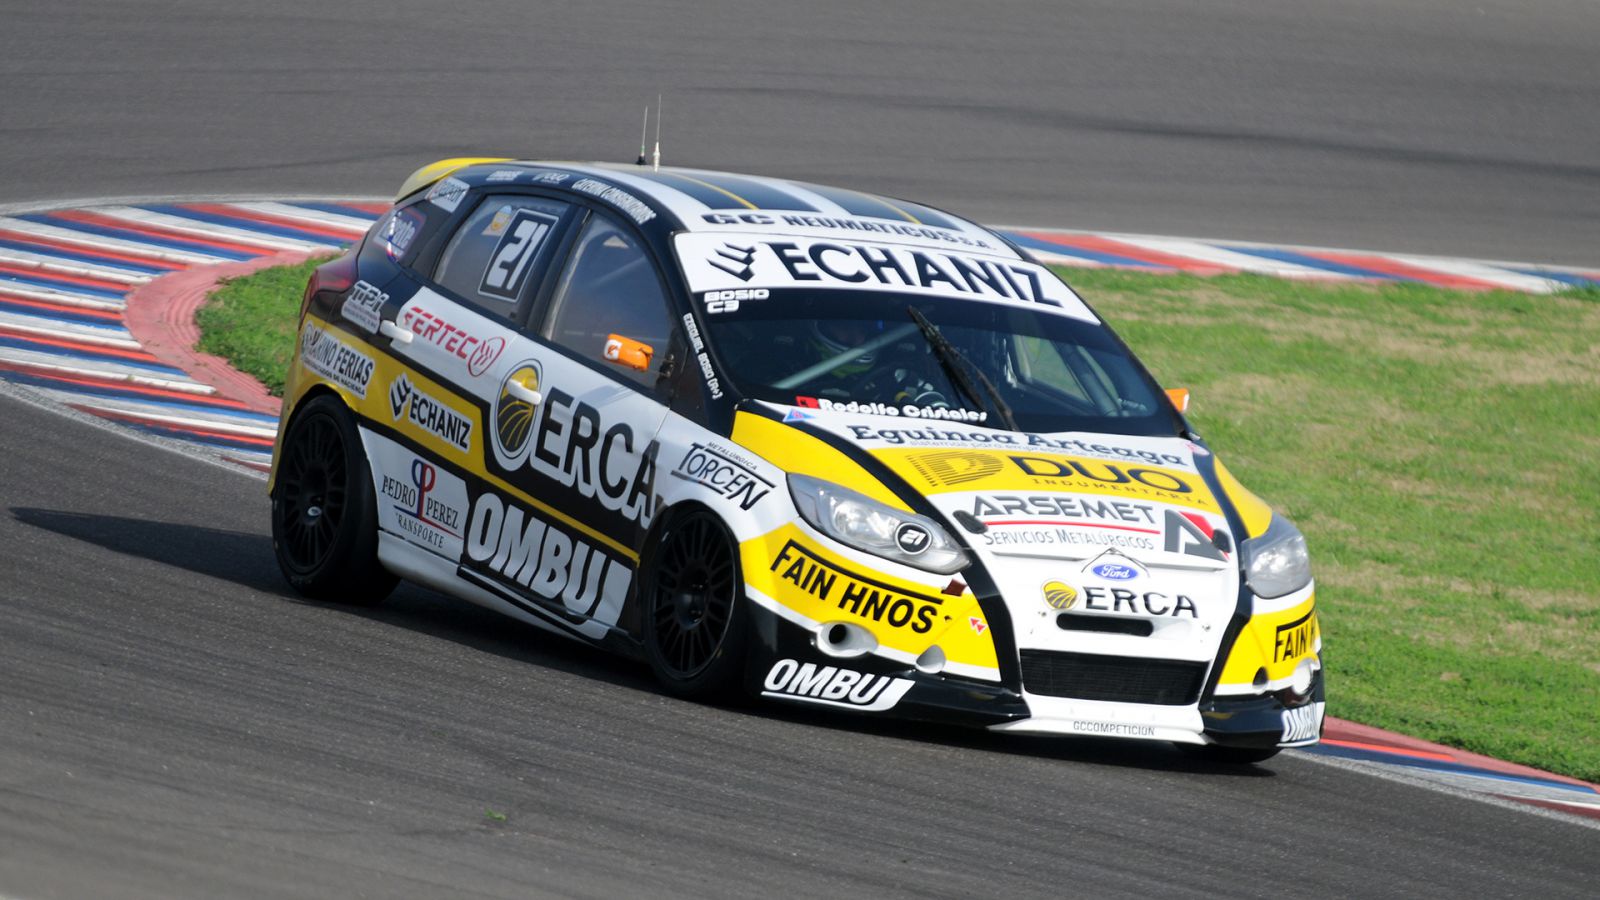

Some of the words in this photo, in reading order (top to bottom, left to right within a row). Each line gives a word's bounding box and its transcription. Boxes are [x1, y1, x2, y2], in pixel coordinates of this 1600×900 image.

[701, 213, 775, 225] GC
[781, 214, 952, 241] NEUMATICOS
[486, 220, 549, 290] 21
[763, 241, 1064, 308] ECHANIZ
[704, 289, 769, 303] BOSIO
[333, 346, 374, 386] FERIAS
[410, 392, 471, 449] ECHANIZ
[817, 398, 899, 416] Rodolfo
[535, 386, 660, 519] ERCA
[1023, 433, 1188, 466] Arteaga
[678, 442, 770, 511] TORCEN
[1006, 455, 1193, 494] DUO
[1032, 478, 1209, 506] INDUMENTARIA
[381, 475, 416, 508] PEDRO
[426, 497, 459, 530] PEREZ
[973, 495, 1156, 524] ARSEMET
[467, 492, 607, 617] OMBU
[900, 529, 927, 546] 21
[983, 527, 1054, 546] SERVICIOS
[770, 539, 837, 600] FAIN
[838, 582, 938, 633] HNOS
[1099, 564, 1131, 579] Ford
[1082, 586, 1198, 619] ERCA
[1274, 625, 1309, 663] FAIN
[764, 659, 879, 704] OMBU
[1073, 721, 1155, 736] GCCOMPETICION
